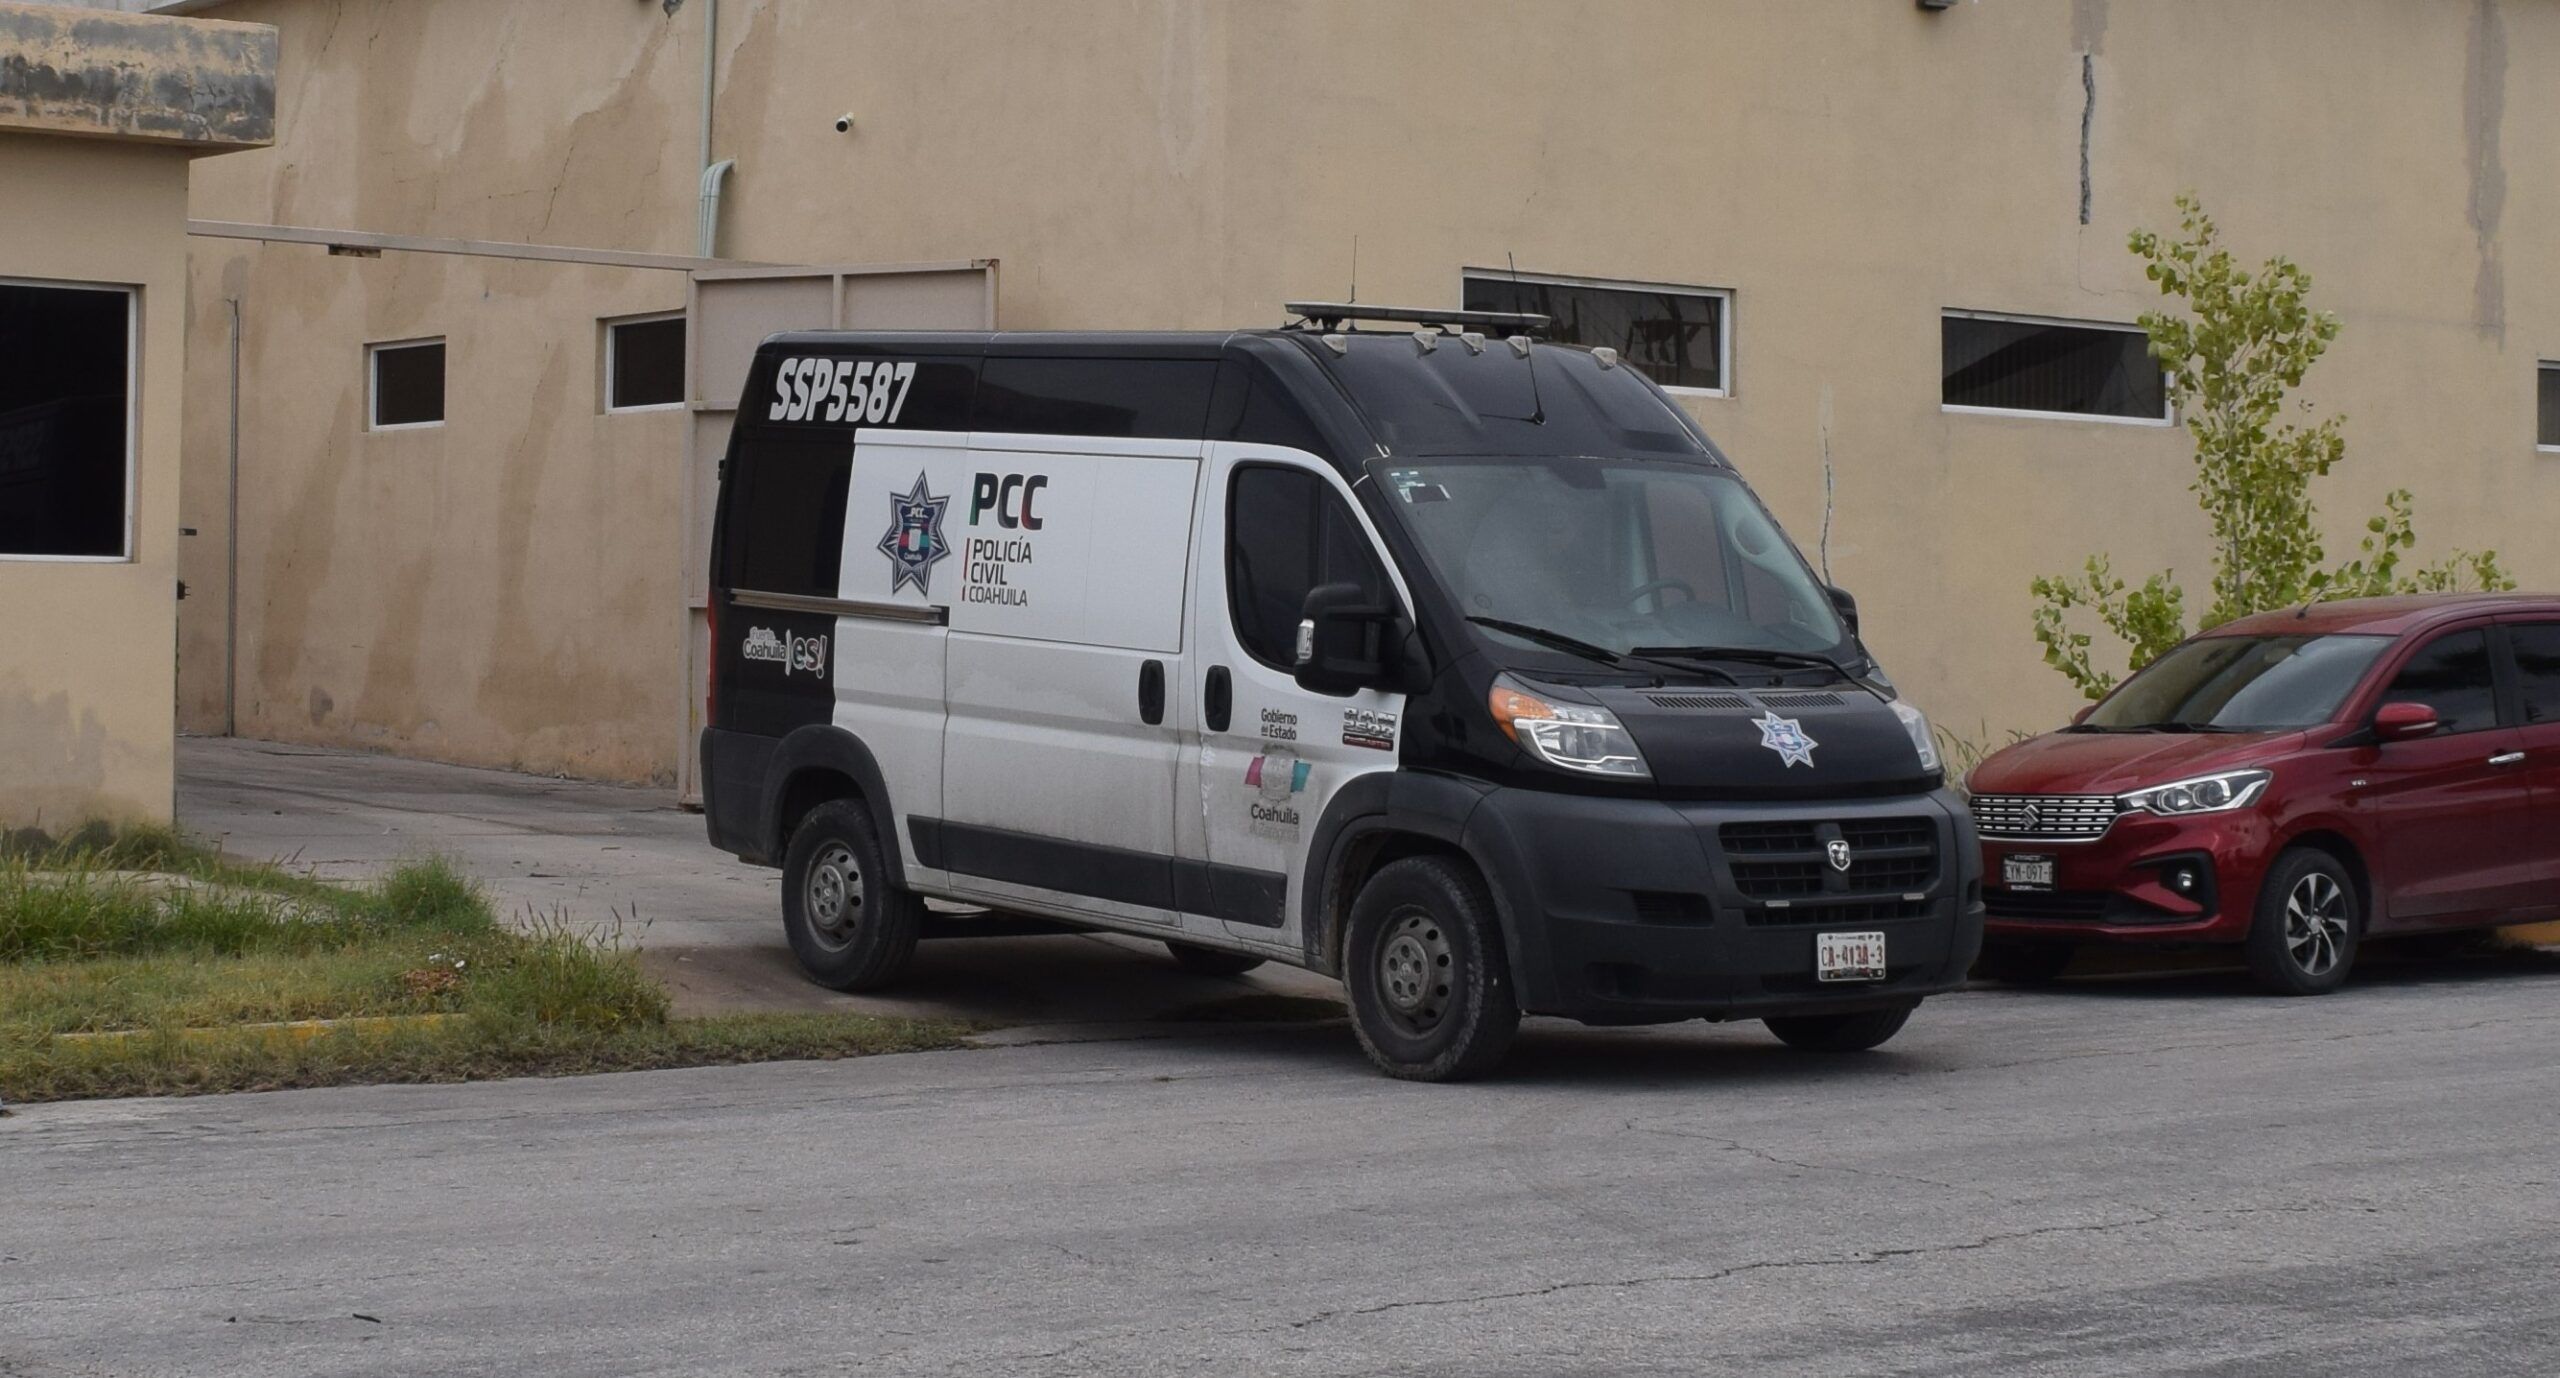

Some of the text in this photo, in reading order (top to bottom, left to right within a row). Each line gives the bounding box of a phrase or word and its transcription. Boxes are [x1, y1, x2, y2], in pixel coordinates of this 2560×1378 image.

[768, 358, 916, 424] SSP5587
[969, 472, 1049, 531] PCC
[972, 535, 1033, 564] POLICÍA
[970, 561, 1008, 586] CIVIL
[968, 585, 1029, 607] COAHUILA
[744, 639, 787, 661] Coahuila
[1261, 707, 1298, 725] Gobierno
[1269, 724, 1297, 741] Estado
[1250, 803, 1299, 825] Coahuila
